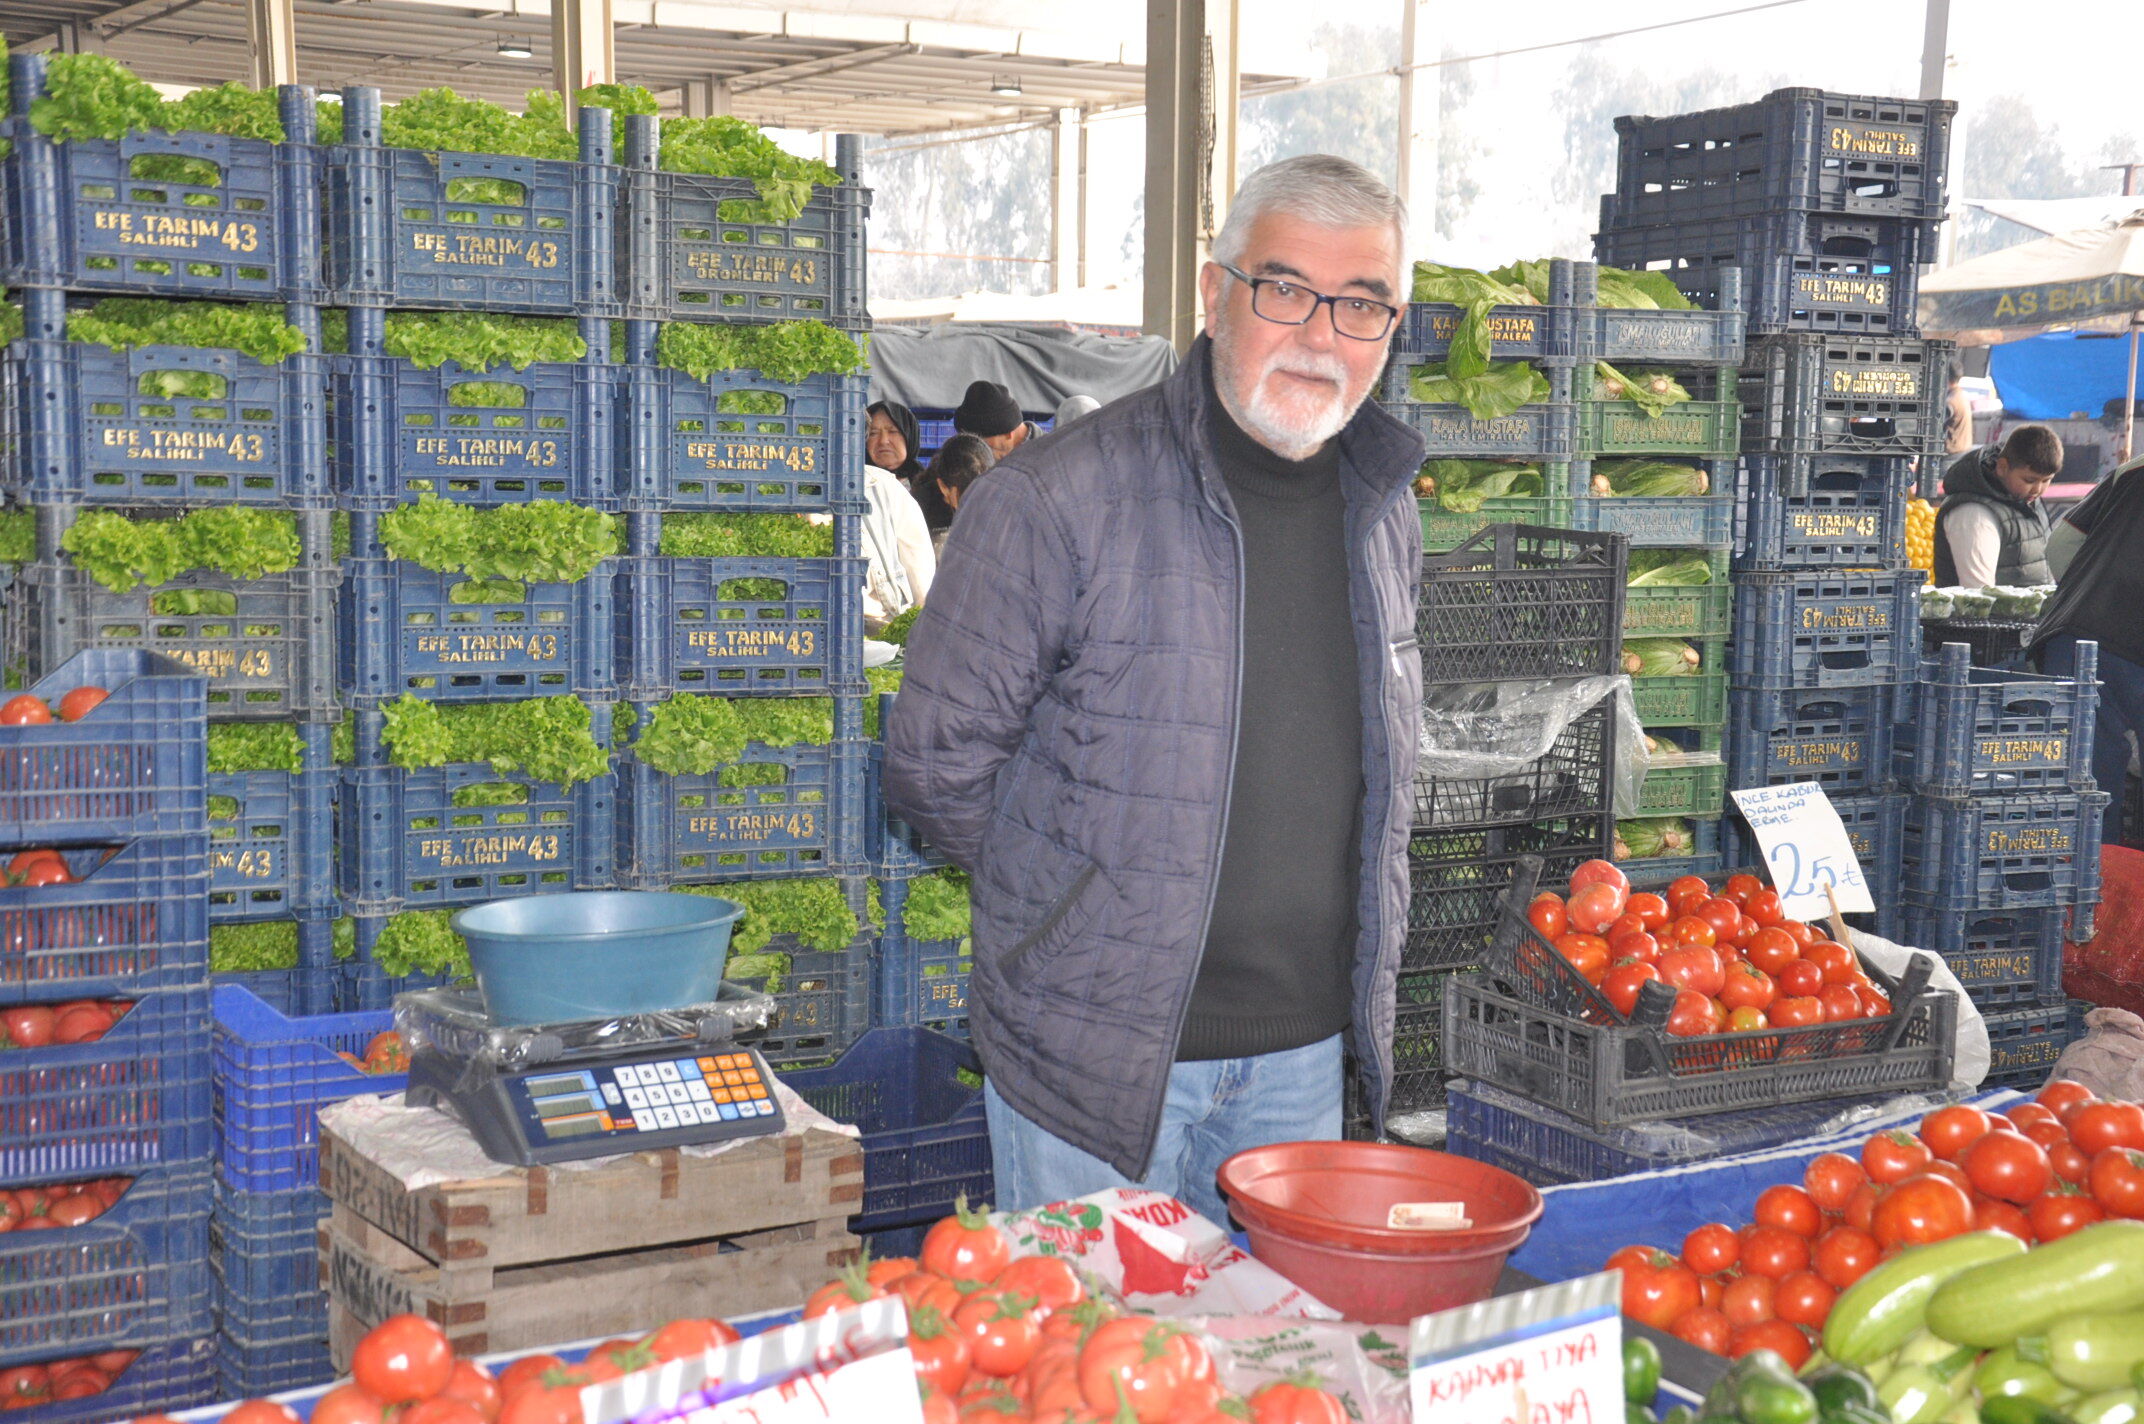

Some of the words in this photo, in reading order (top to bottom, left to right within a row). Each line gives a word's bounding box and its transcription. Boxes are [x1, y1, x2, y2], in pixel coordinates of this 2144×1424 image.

[1831, 128, 1852, 150] 43
[1852, 139, 1892, 154] TARIM
[1897, 142, 1916, 155] EFE
[95, 211, 132, 230] EFE
[142, 215, 219, 237] TARIM
[221, 222, 258, 251] 43
[413, 233, 447, 250] EFE
[456, 235, 522, 255] TARIM
[526, 241, 557, 268] 43
[687, 252, 721, 269] EFE
[732, 254, 787, 272] TARIM
[790, 259, 816, 285] 43
[1800, 279, 1820, 292] EFE
[1825, 280, 1865, 295] TARIM
[1865, 283, 1885, 304] 43
[1994, 292, 2039, 318] AS
[1833, 370, 1852, 392] 43
[103, 429, 140, 446] EFE
[150, 430, 226, 448] TARIM
[228, 434, 263, 462] 43
[416, 438, 448, 454] EFE
[456, 438, 523, 455] TARIM
[526, 440, 557, 467] 43
[687, 443, 717, 458] EFE
[724, 444, 785, 460] TARIM
[786, 446, 814, 471] 43
[1794, 515, 1813, 527] EFE
[1818, 515, 1856, 527] TARIM
[1856, 516, 1875, 536] 43
[1803, 607, 1823, 629] 43
[1823, 615, 1863, 628] TARIM
[1868, 613, 1886, 626] EFE
[418, 636, 450, 652] EFE
[458, 634, 524, 650] TARIM
[526, 634, 557, 661] 43
[689, 631, 717, 646] EFE
[725, 630, 784, 645] TARIM
[786, 630, 814, 656] 43
[240, 649, 271, 677] 43
[1777, 745, 1796, 759] EFE
[1801, 742, 1840, 756] TARIM
[1841, 741, 1859, 762] 43
[1981, 742, 2000, 755] EFE
[2005, 741, 2042, 753] TARIM
[2044, 740, 2061, 760] 43
[689, 817, 718, 832] EFE
[727, 814, 785, 830] TARIM
[787, 813, 814, 838] 43
[421, 839, 452, 857] EFE
[461, 835, 526, 853] TARIM
[528, 835, 558, 861] 43
[1989, 830, 2008, 851] 43
[2009, 837, 2046, 851] TARIM
[2051, 836, 2070, 849] EFE
[237, 850, 271, 878] 43
[1950, 960, 1969, 972] EFE
[1974, 957, 2011, 970] TARIM
[2013, 955, 2030, 976] 43
[933, 984, 958, 1000] EFE
